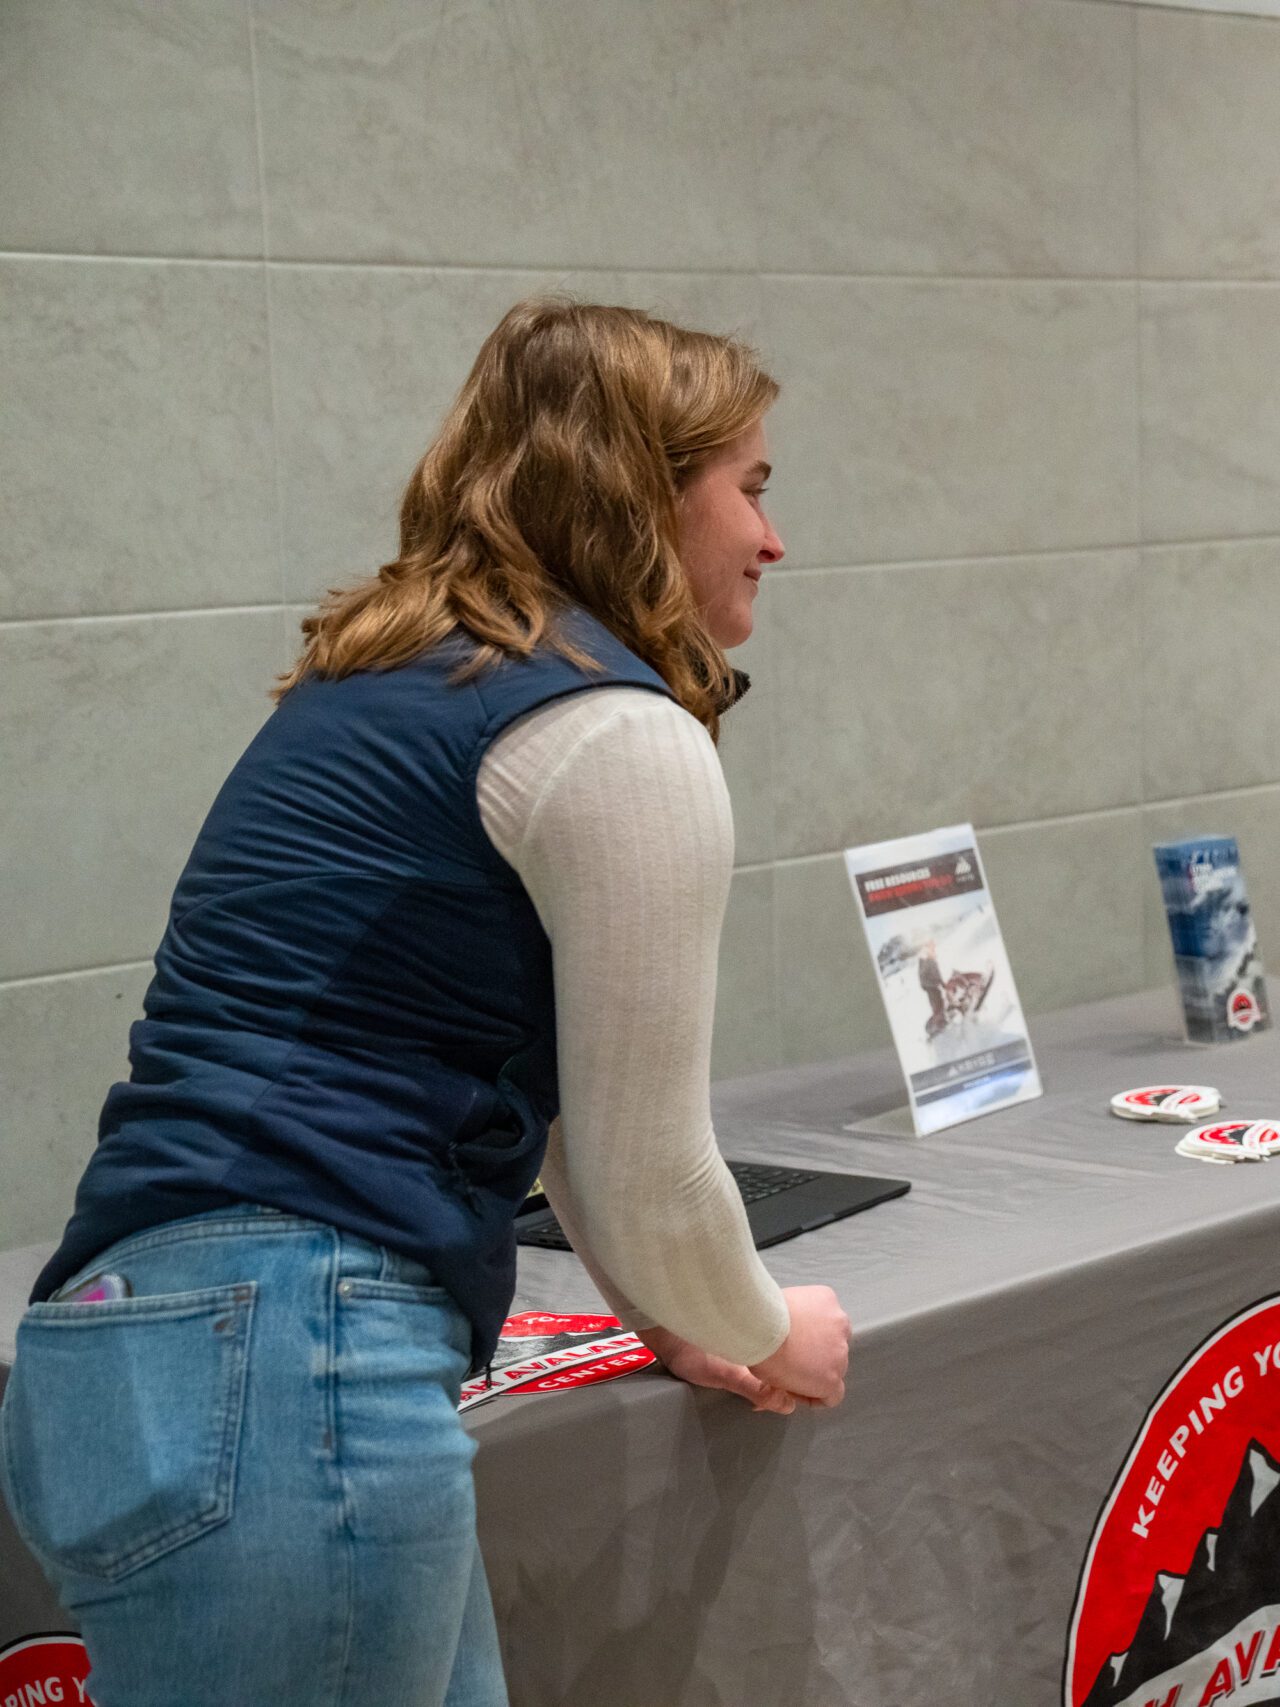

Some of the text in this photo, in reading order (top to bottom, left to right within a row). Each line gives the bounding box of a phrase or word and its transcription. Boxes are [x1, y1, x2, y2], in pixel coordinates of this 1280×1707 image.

[503, 1337, 641, 1380] AVALAN
[537, 1354, 647, 1389] CENTER
[1131, 1365, 1245, 1539] KEEPING
